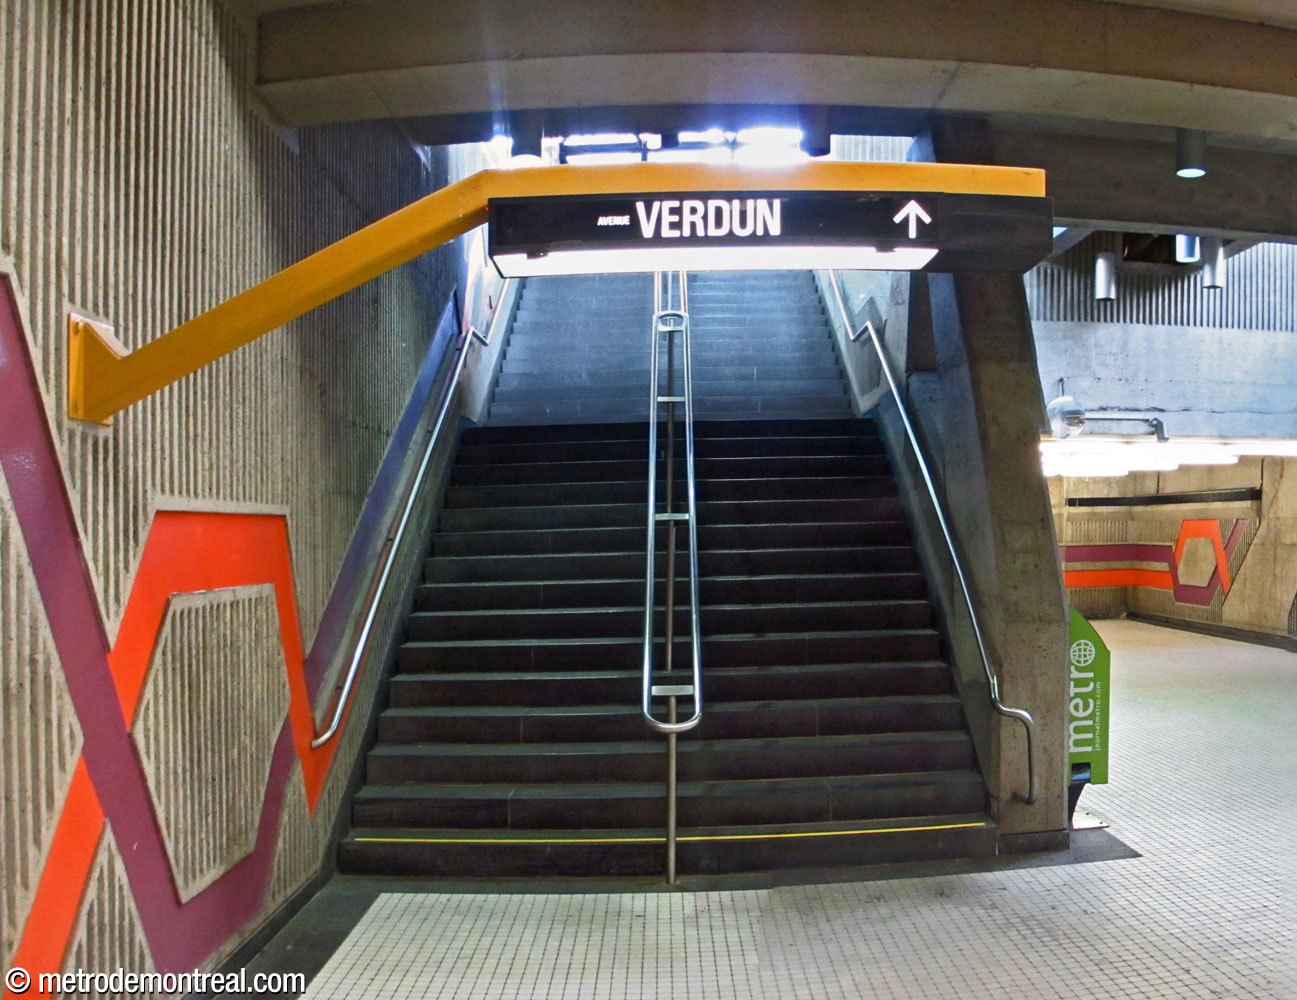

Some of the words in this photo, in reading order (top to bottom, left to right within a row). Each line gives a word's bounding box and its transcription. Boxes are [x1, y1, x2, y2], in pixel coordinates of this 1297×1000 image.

[597, 215, 631, 226] AVENUE
[635, 199, 781, 238] VERDUN
[1069, 639, 1096, 753] metro
[1094, 681, 1102, 751] journalmetro.com
